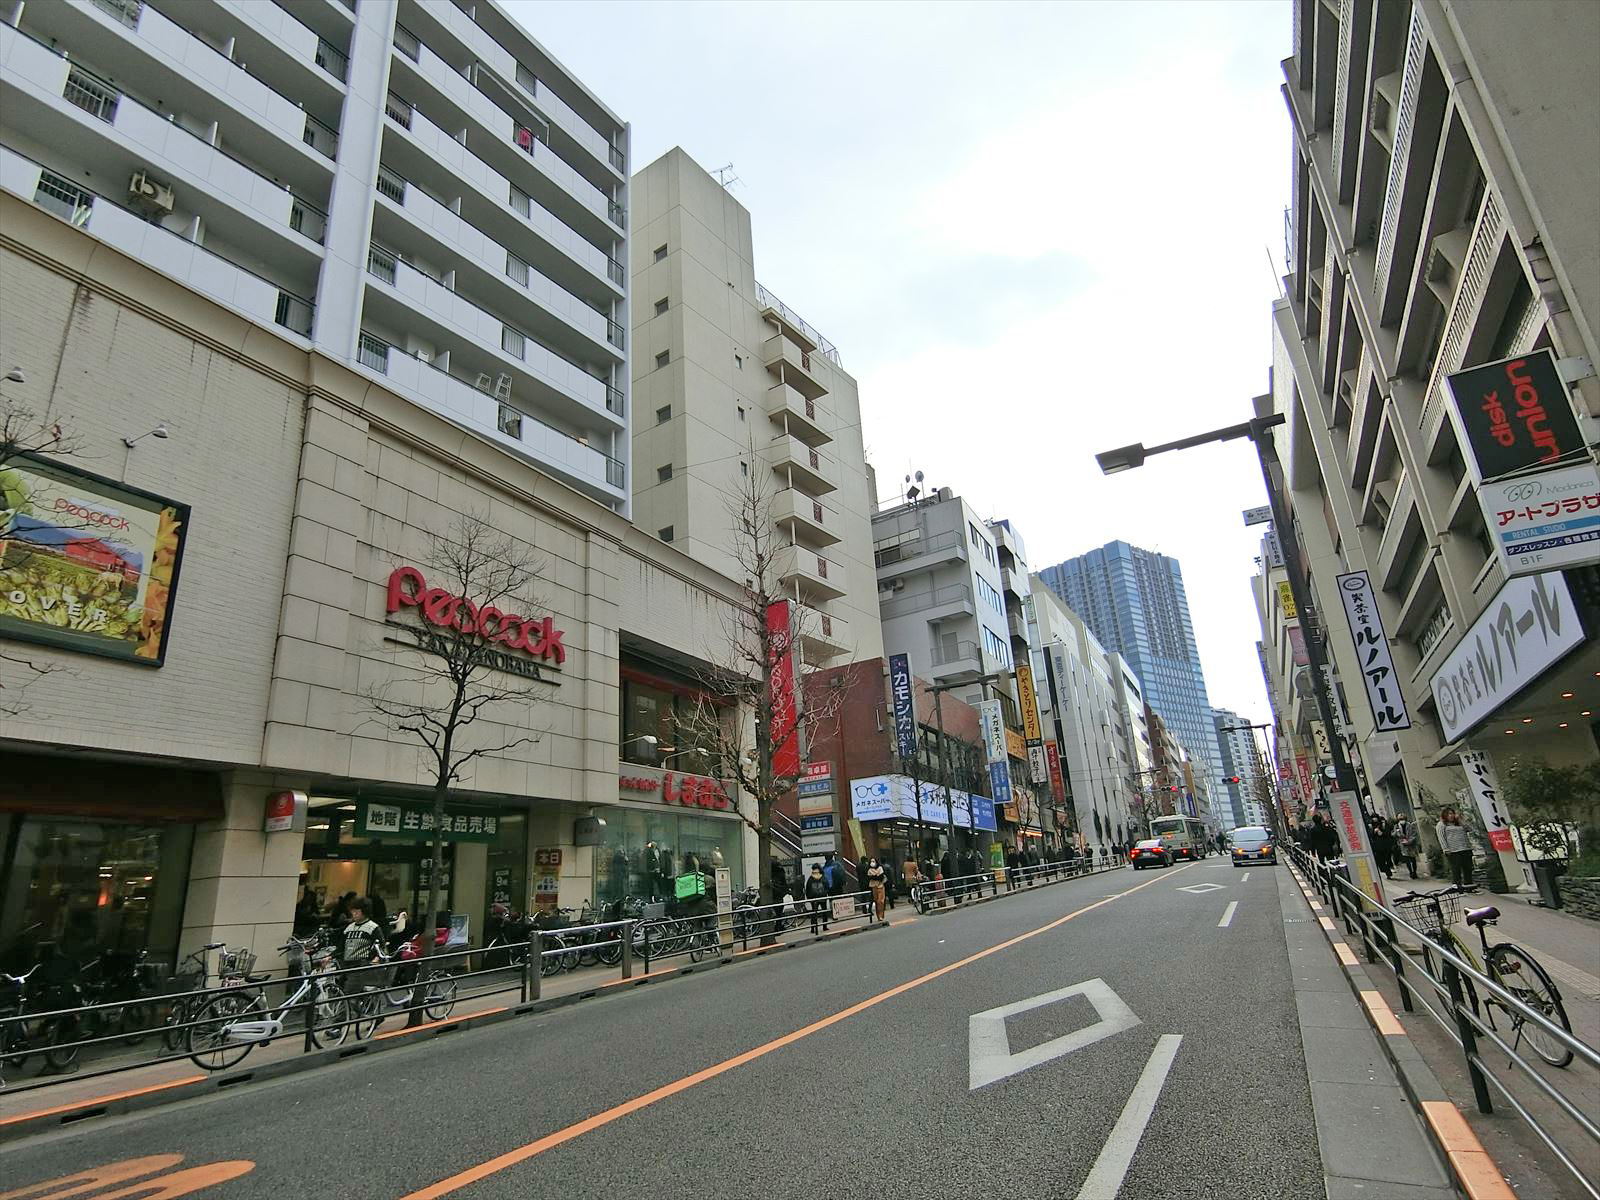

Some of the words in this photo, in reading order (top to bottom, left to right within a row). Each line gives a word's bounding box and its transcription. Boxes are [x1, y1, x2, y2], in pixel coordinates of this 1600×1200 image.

[1481, 390, 1515, 447] disk
[1505, 359, 1561, 464] union
[1512, 530, 1538, 540] RENTAL
[1543, 523, 1566, 534] STUDIO
[1520, 554, 1543, 565] B1F
[894, 671, 911, 729] カモシカ
[1021, 678, 1036, 737] やきとりセンター
[991, 713, 1003, 756] メガネスーパー
[369, 810, 398, 826] 地階
